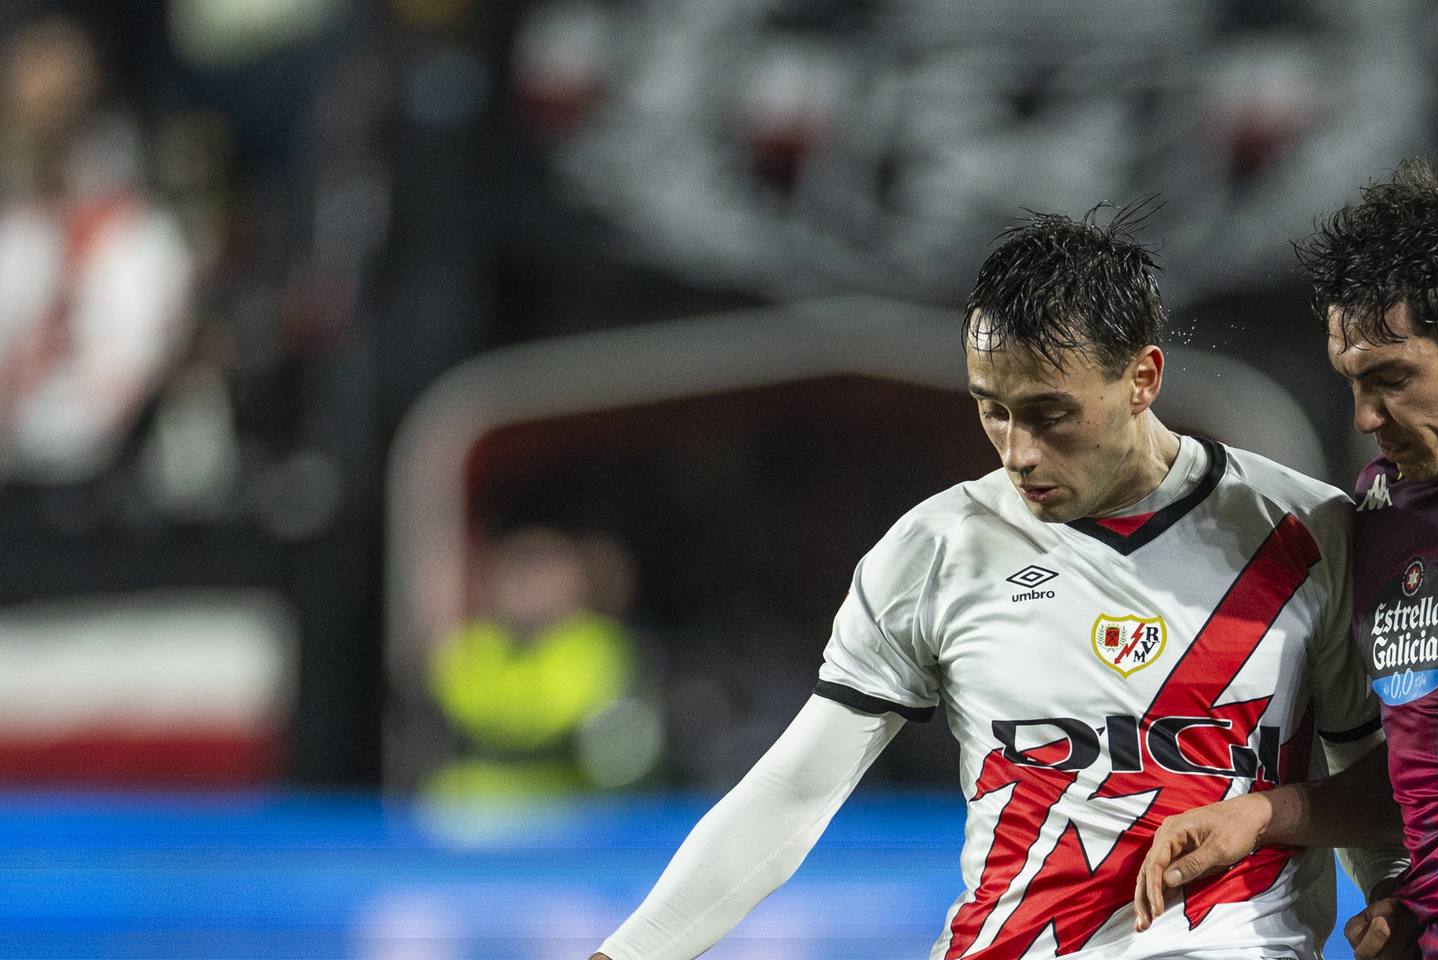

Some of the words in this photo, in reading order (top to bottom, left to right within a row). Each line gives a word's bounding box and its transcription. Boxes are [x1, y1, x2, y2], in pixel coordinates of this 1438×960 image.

[1011, 590, 1056, 603] umbro
[1372, 630, 1438, 671] Galicia
[991, 715, 1281, 786] DIGI
